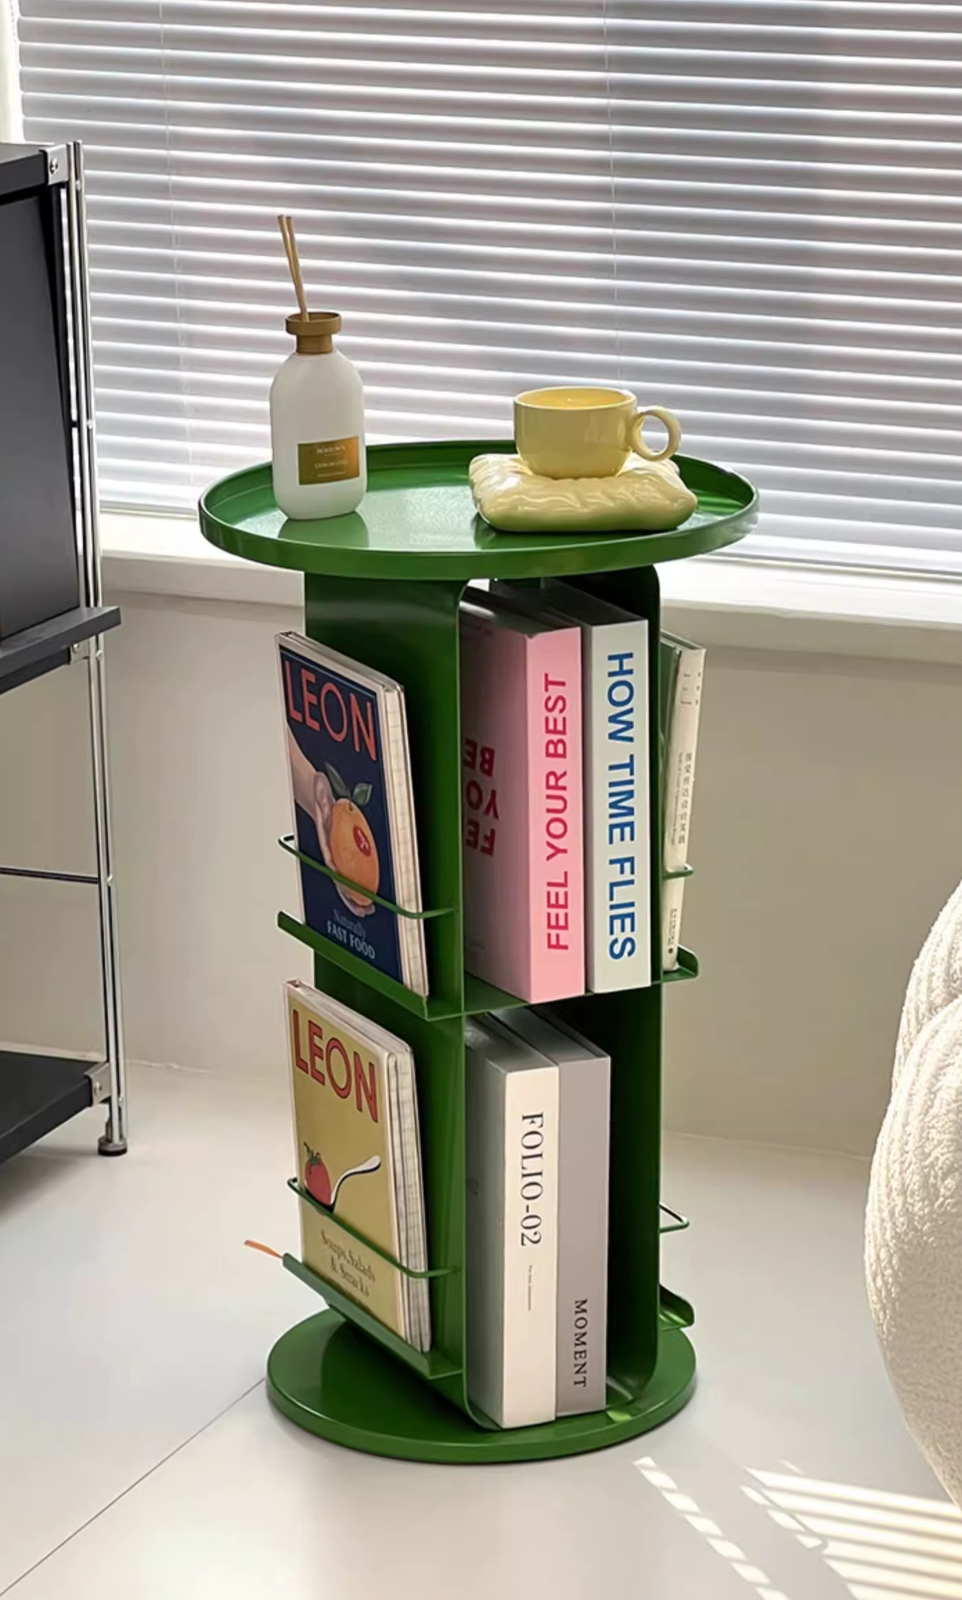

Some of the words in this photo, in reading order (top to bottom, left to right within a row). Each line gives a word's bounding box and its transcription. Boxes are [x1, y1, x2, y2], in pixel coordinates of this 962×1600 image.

[284, 660, 378, 762] LEON
[544, 673, 567, 759] BEST
[607, 652, 635, 743] HOW
[546, 770, 568, 861] YOUR
[607, 754, 635, 845] TIME
[326, 920, 348, 944] FAST
[349, 933, 376, 960] FOOD
[546, 871, 569, 950] FEEL
[608, 856, 636, 960] FLIES
[293, 1009, 378, 1123] LEON
[519, 1112, 544, 1247] FOLIO-02
[573, 1298, 588, 1388] MOMENT
